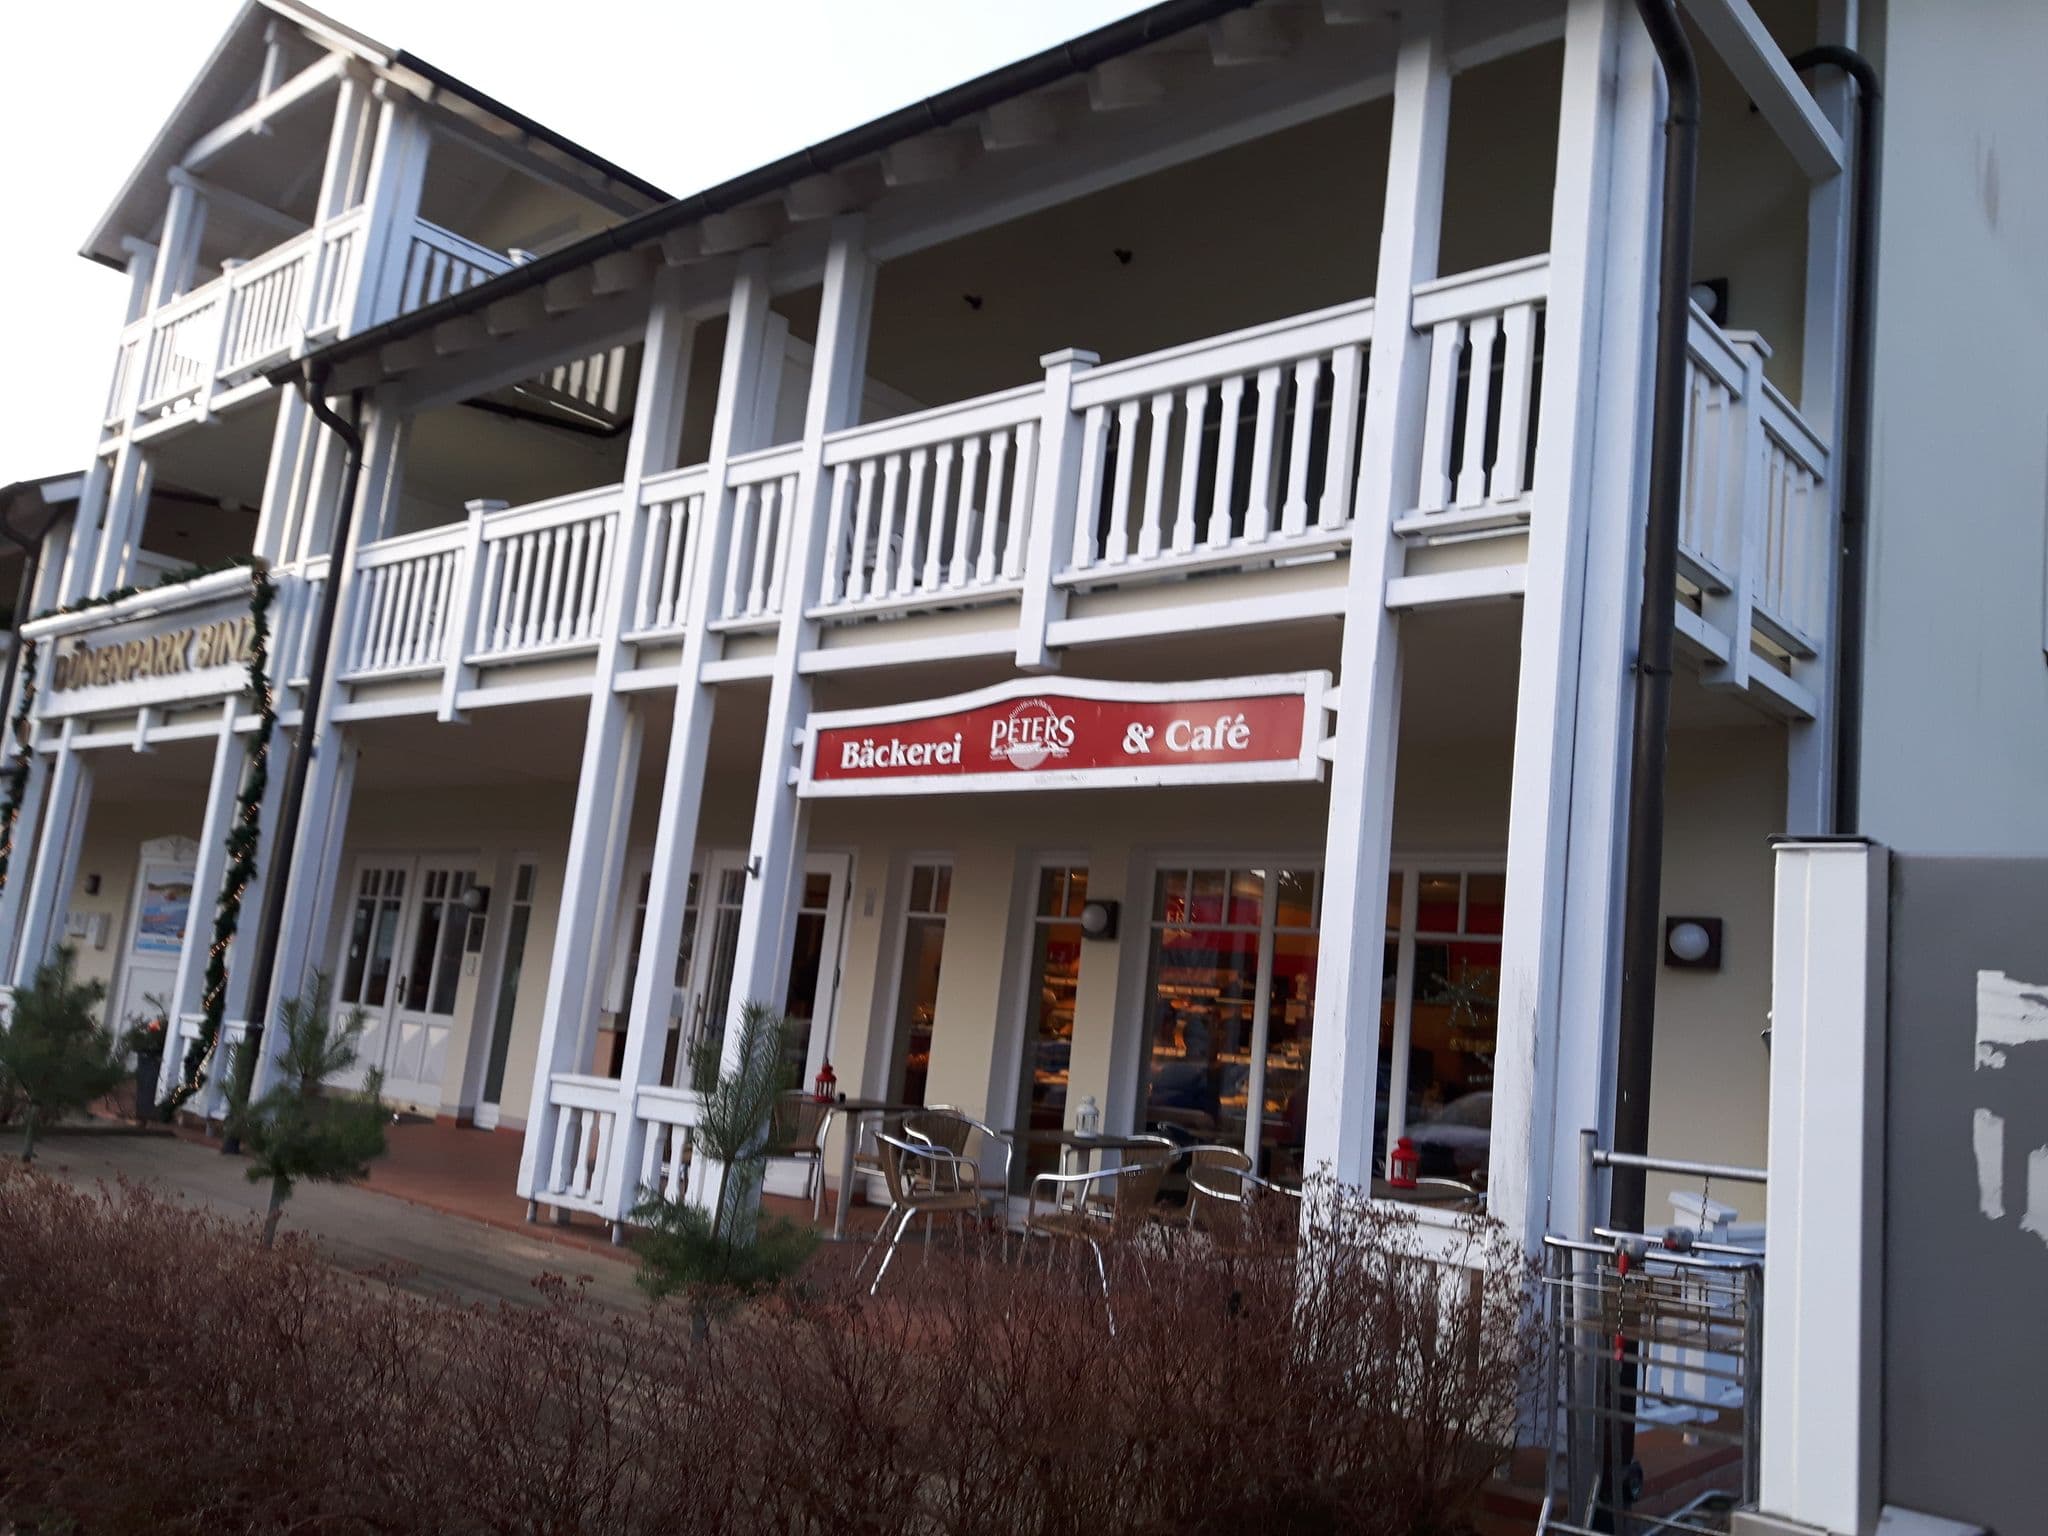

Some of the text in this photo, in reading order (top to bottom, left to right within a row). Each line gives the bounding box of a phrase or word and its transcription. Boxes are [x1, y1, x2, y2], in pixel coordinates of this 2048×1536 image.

[54, 628, 193, 692] DÜNENPARK
[840, 731, 963, 770] Bäckerei
[989, 714, 1076, 750] PETERS
[1122, 713, 1251, 755] & Café
